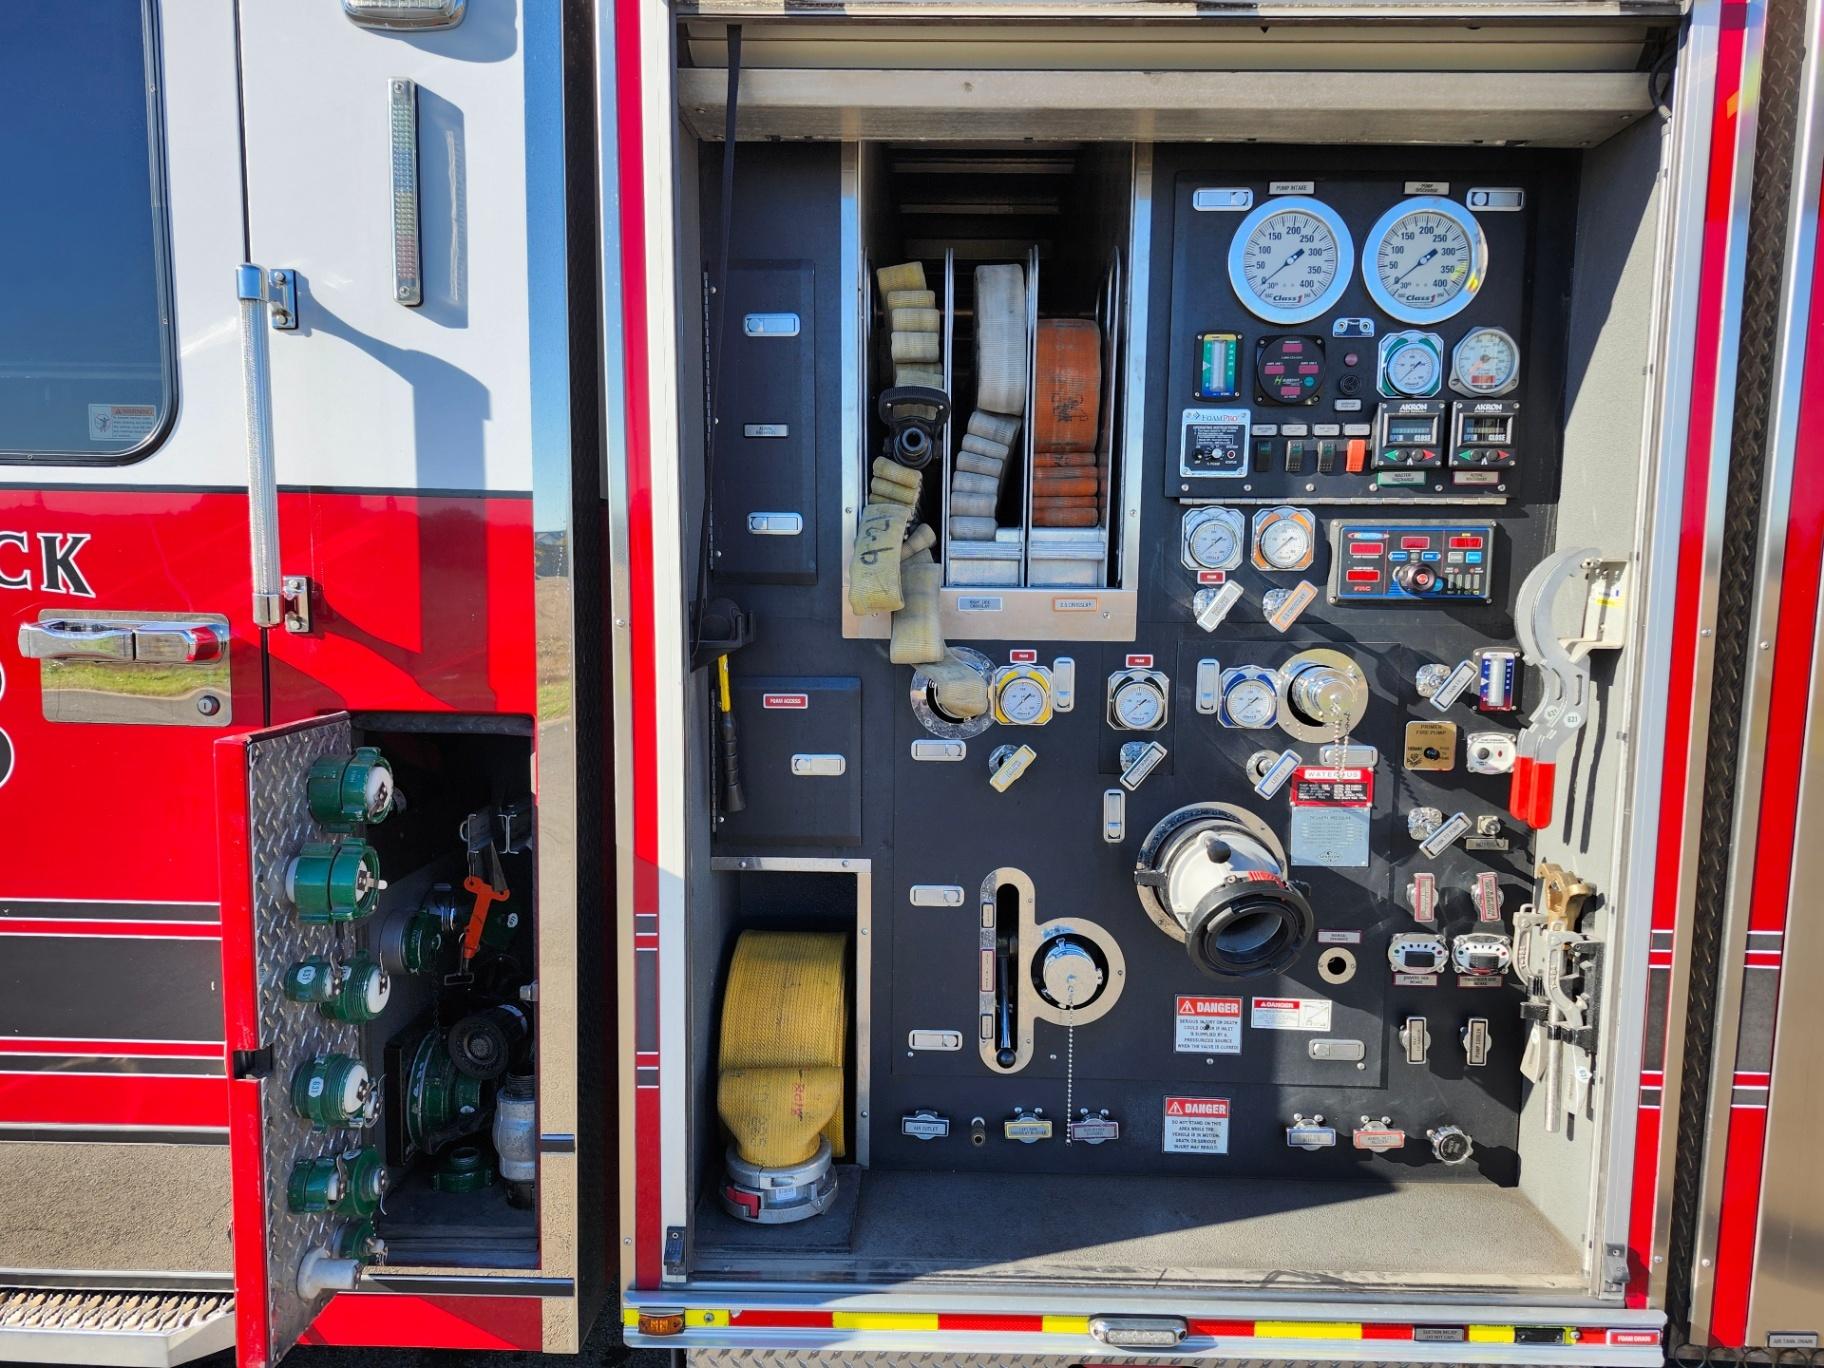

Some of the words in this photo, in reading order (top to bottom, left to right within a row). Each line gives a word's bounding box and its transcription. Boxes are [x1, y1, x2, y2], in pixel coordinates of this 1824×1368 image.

[1286, 226, 1301, 235] 200
[1419, 226, 1434, 234] 200
[1268, 232, 1282, 240] 150
[1300, 234, 1314, 243] 250
[1401, 232, 1415, 240] 150
[1433, 234, 1447, 242] 250
[1259, 246, 1271, 254] 100
[1308, 248, 1323, 256] 300
[1392, 246, 1404, 254] 100
[1441, 248, 1456, 256] 300
[1256, 261, 1265, 269] 50
[1389, 261, 1398, 269] 50
[1307, 266, 1322, 274] 350
[1440, 266, 1455, 274] 350
[1300, 280, 1314, 288] 400
[1433, 280, 1447, 288] 400
[1399, 403, 1427, 411] AKRON
[1474, 403, 1503, 411] AKRON
[1196, 1002, 1239, 1013] DANGER
[1185, 1103, 1226, 1114] DANGER
